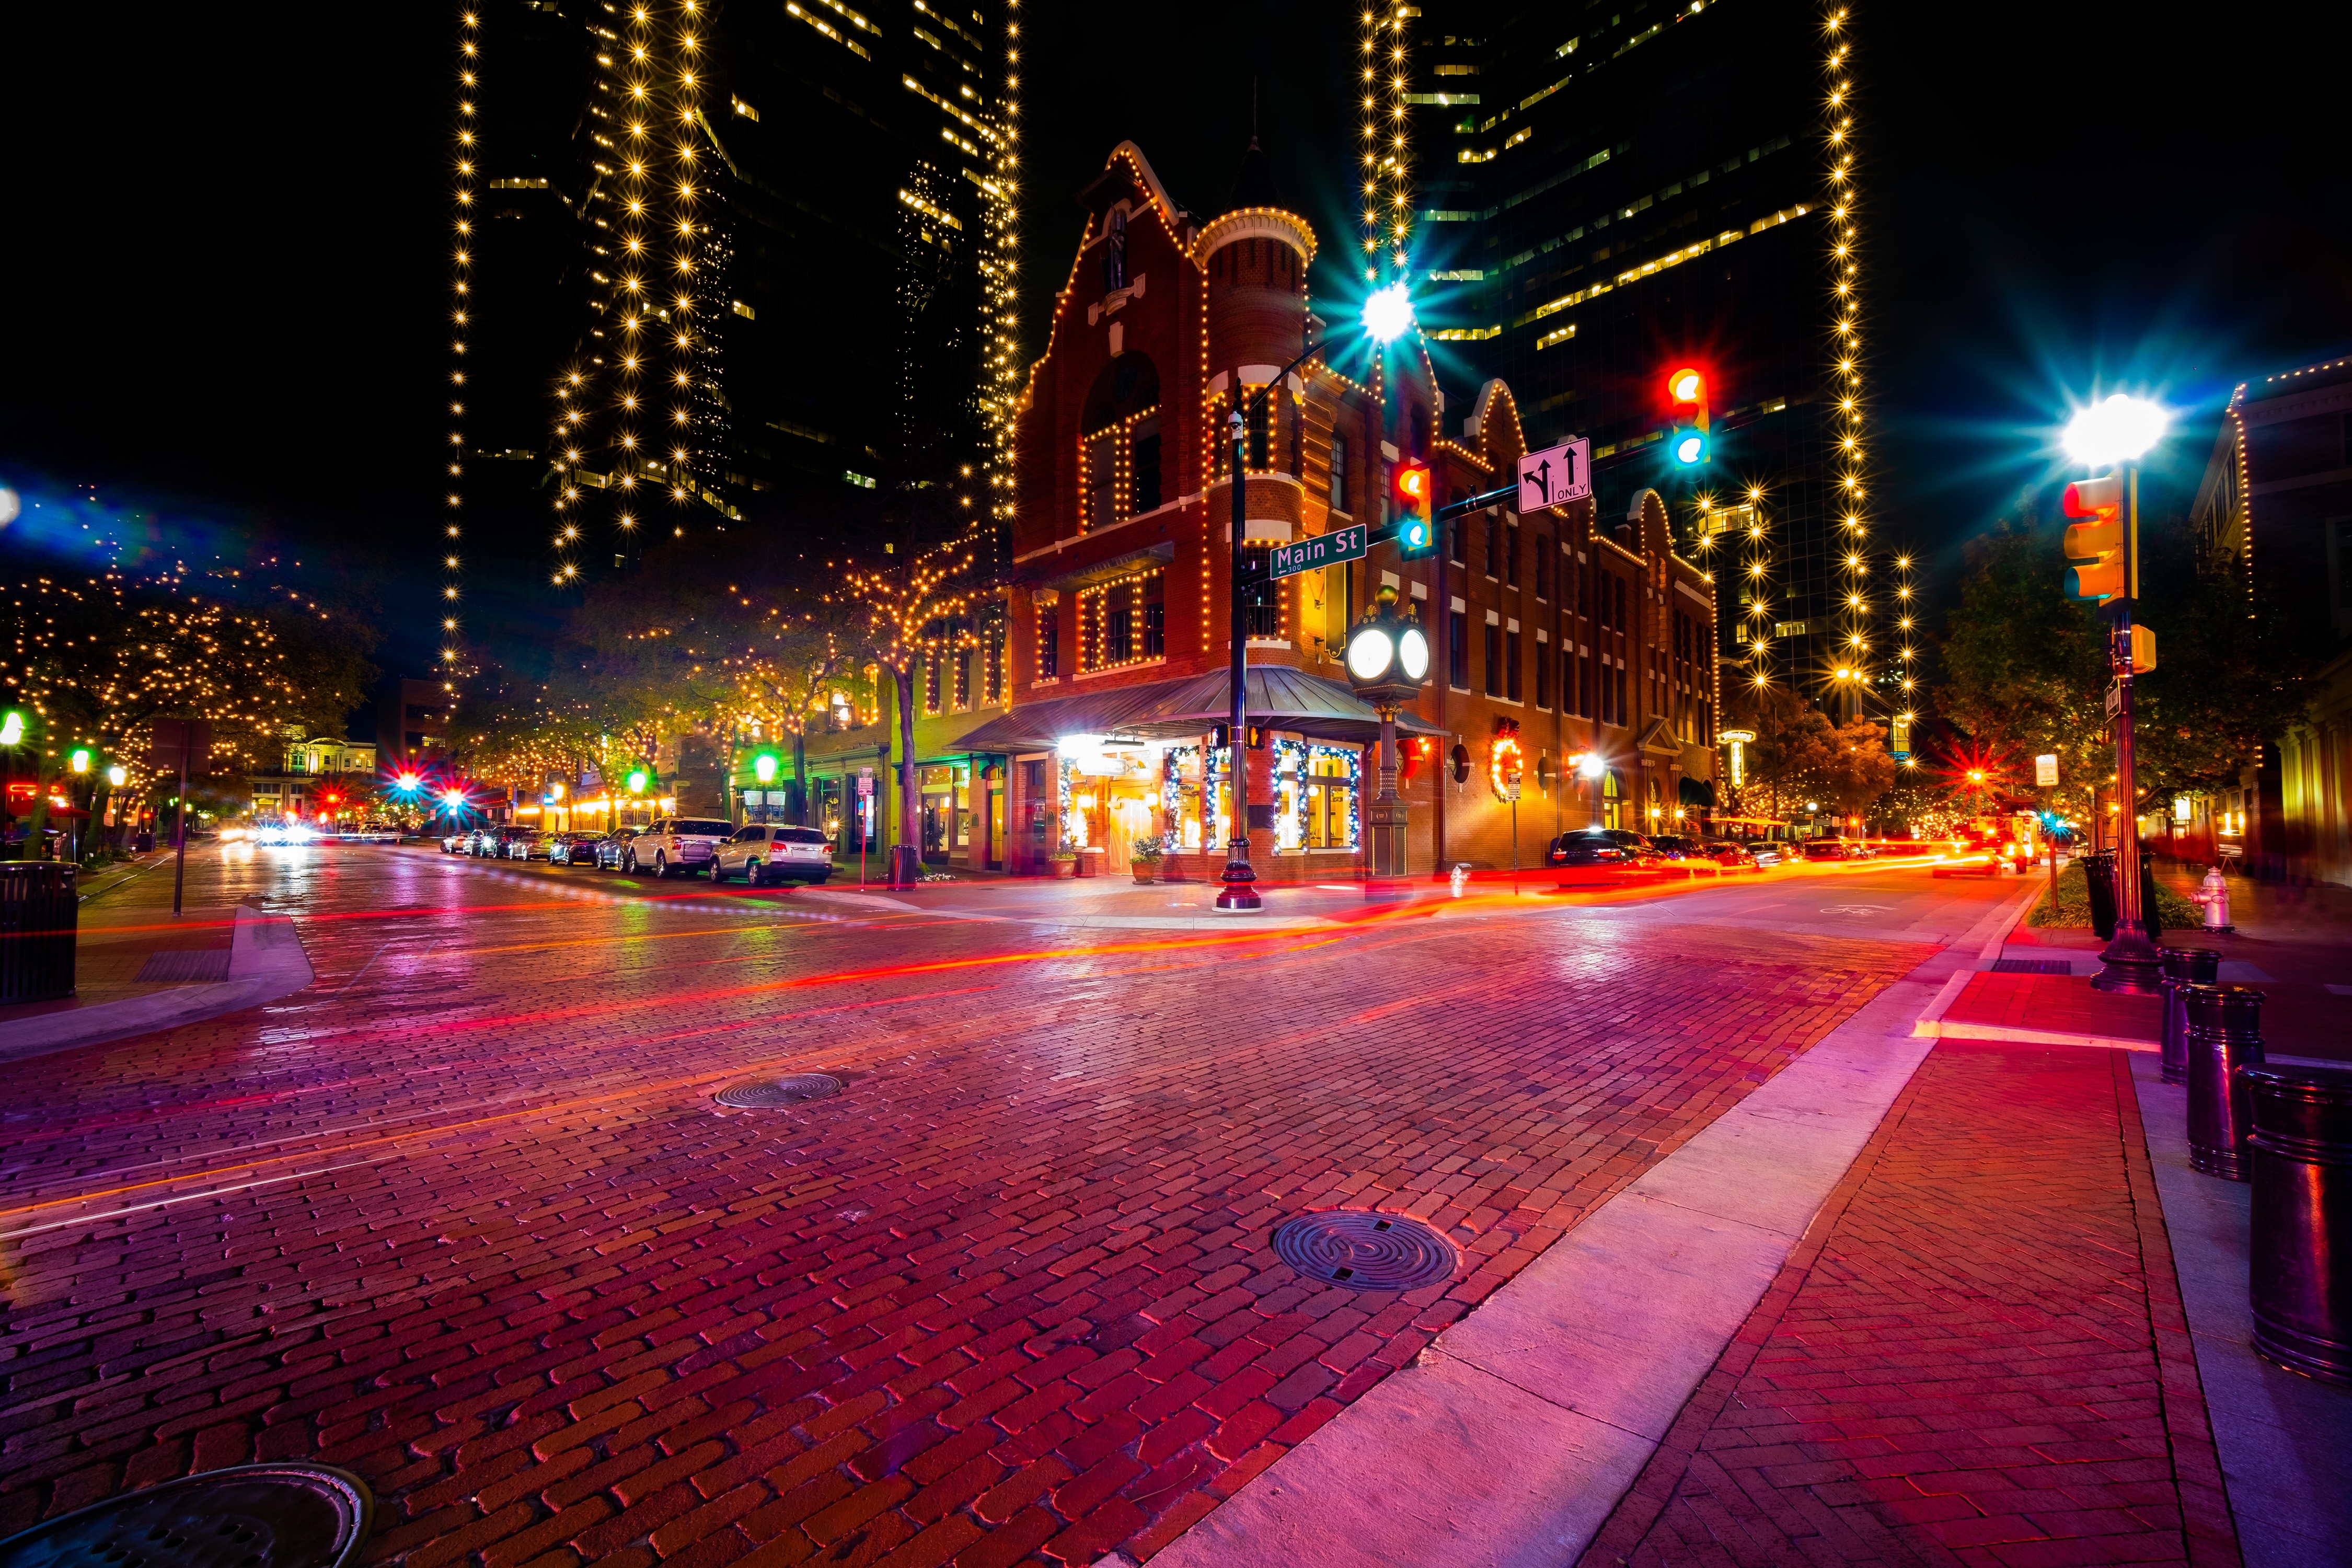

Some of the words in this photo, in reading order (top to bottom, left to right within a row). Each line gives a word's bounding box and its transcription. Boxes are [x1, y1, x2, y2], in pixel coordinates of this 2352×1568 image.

[1558, 483, 1586, 500] ONLY
[1278, 542, 1324, 568] Main
[1335, 531, 1357, 552] St
[1288, 564, 1301, 573] 300
